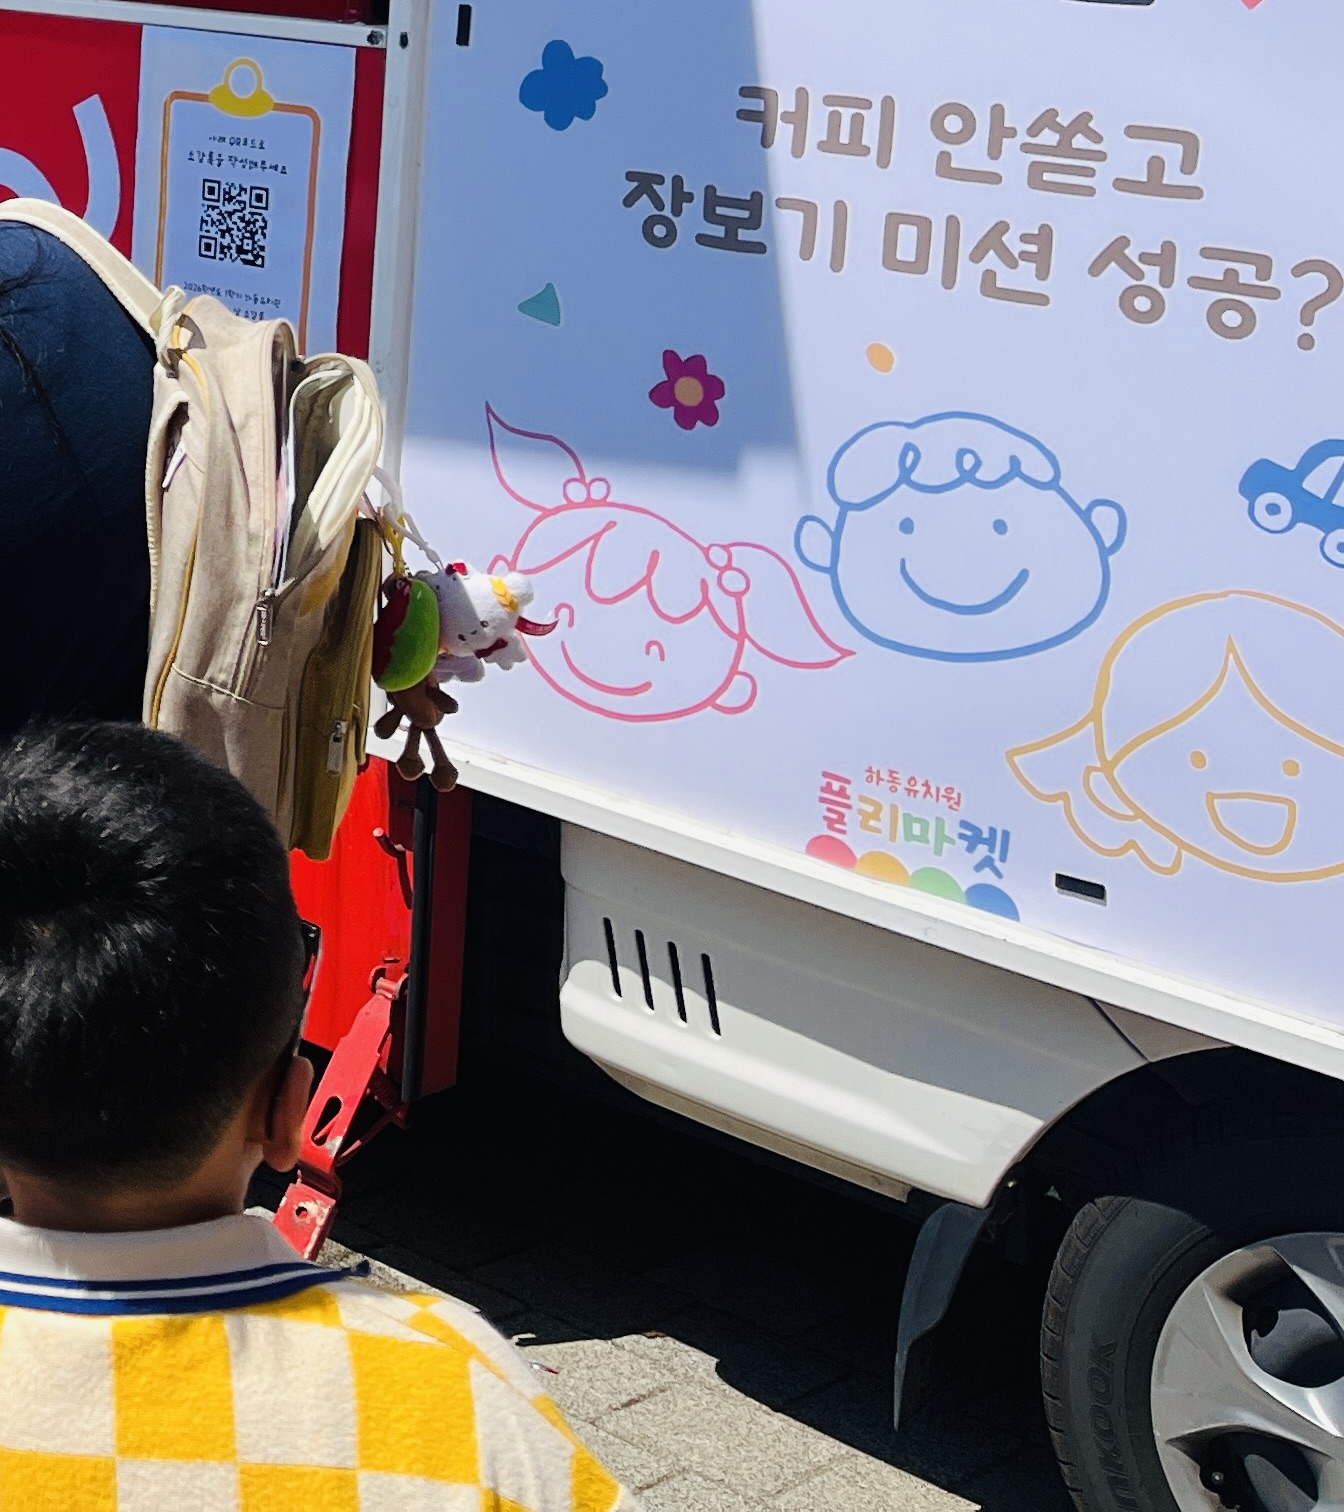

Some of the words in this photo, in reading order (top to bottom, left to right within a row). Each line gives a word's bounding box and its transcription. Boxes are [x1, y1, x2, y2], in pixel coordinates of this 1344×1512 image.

[735, 85, 896, 171] 커피
[929, 102, 1205, 203] 안쏟고
[621, 170, 850, 273] 장보기
[881, 211, 1054, 308] 미션
[1087, 235, 1344, 352] 성공?
[817, 770, 1011, 880] 플리마켓
[864, 765, 962, 812] 하동유치원
